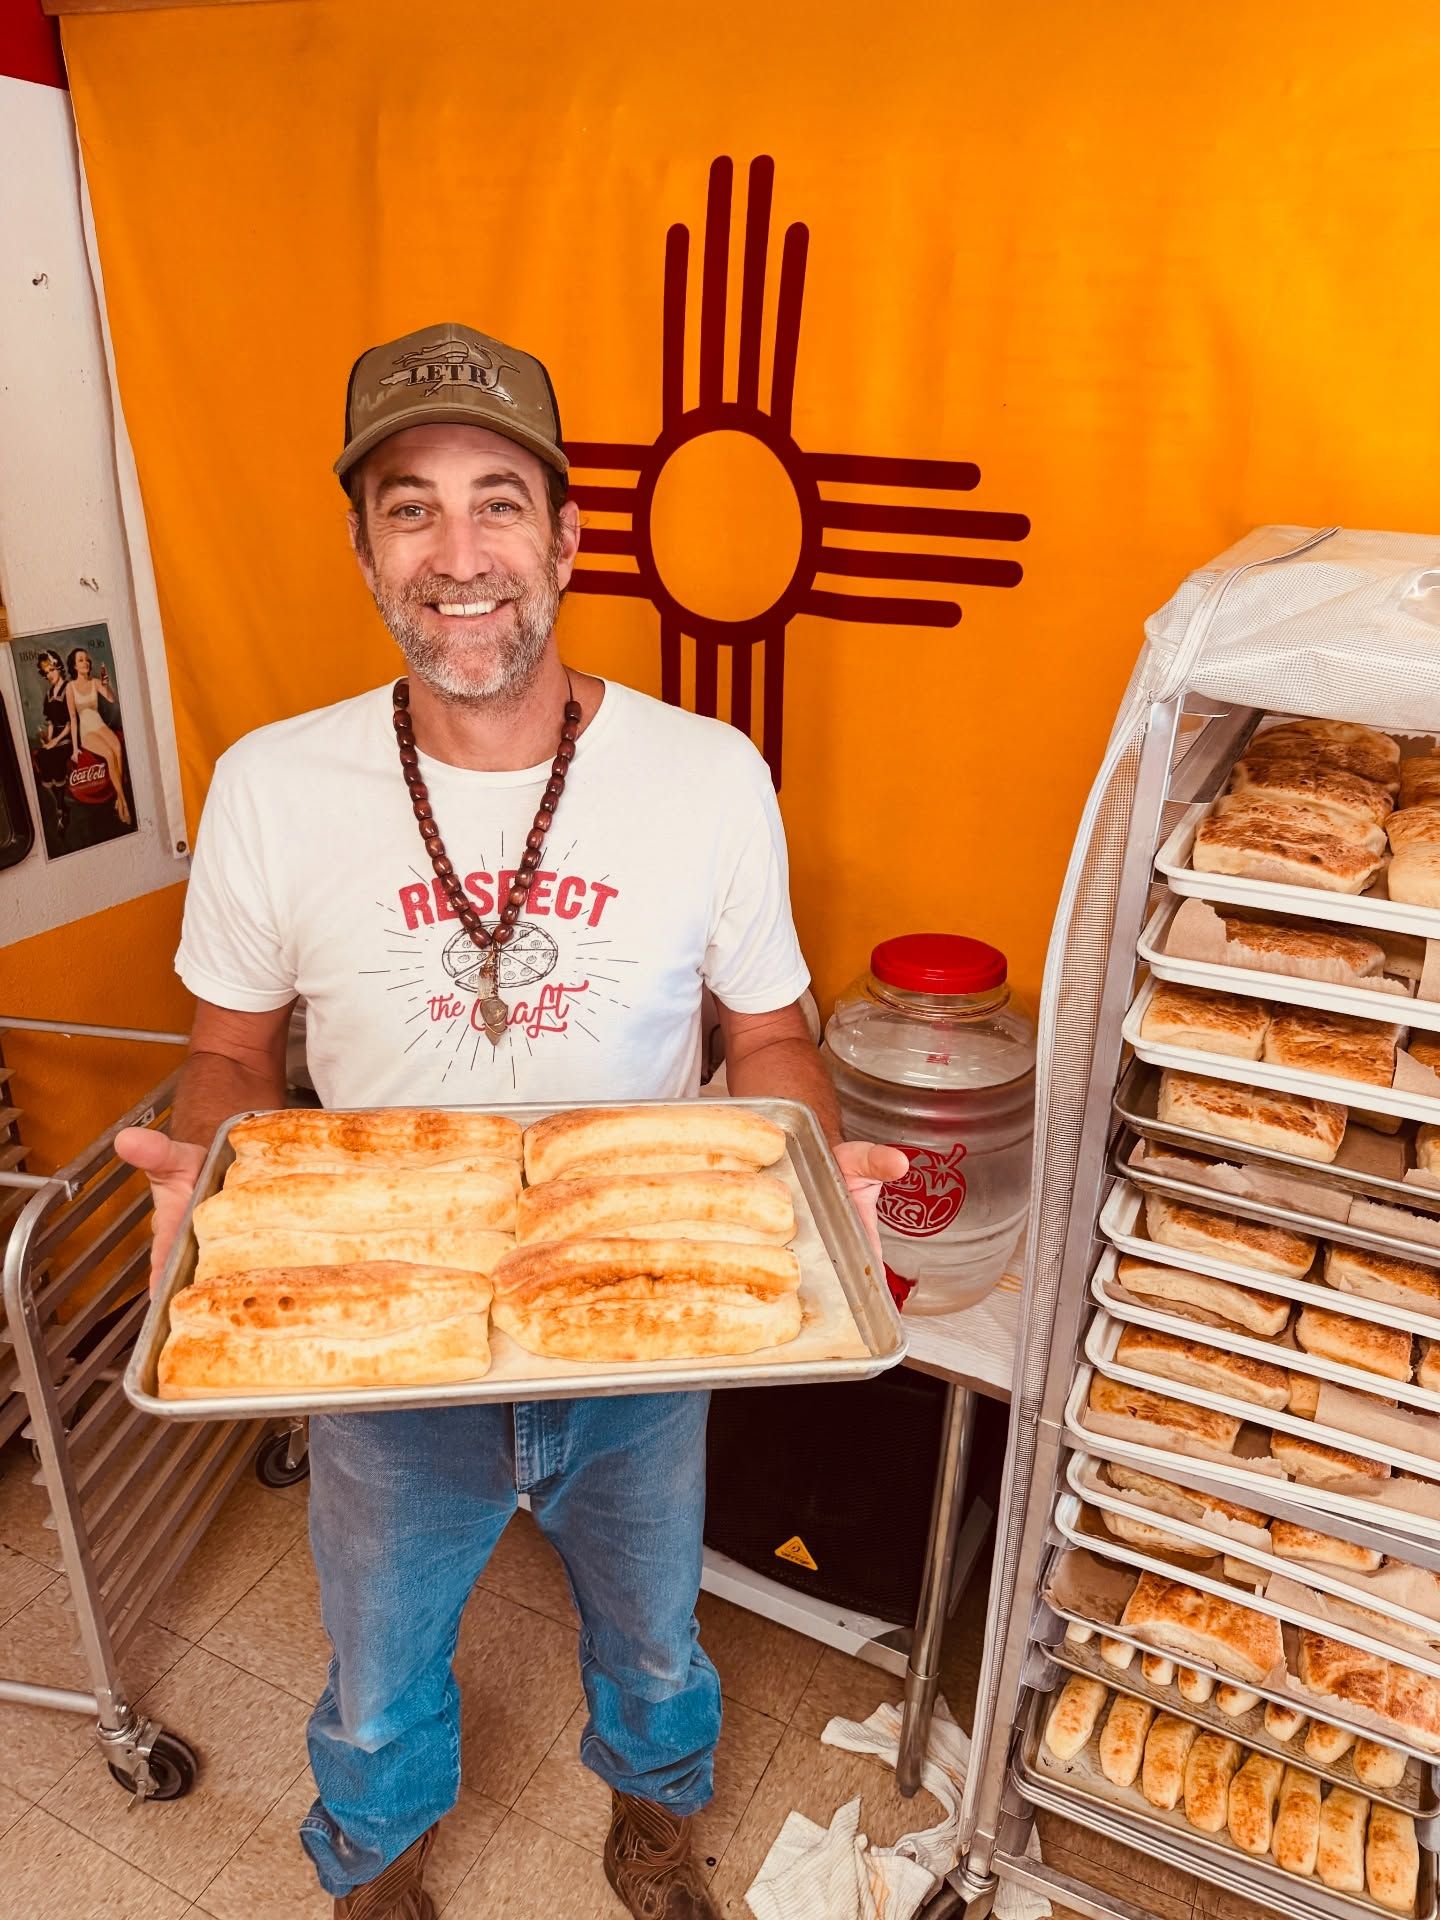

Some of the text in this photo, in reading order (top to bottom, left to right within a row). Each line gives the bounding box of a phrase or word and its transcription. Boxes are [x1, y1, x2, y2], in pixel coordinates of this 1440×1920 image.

[406, 364, 490, 386] LETR
[426, 993, 466, 1022] the
[470, 979, 590, 1039] Caft
